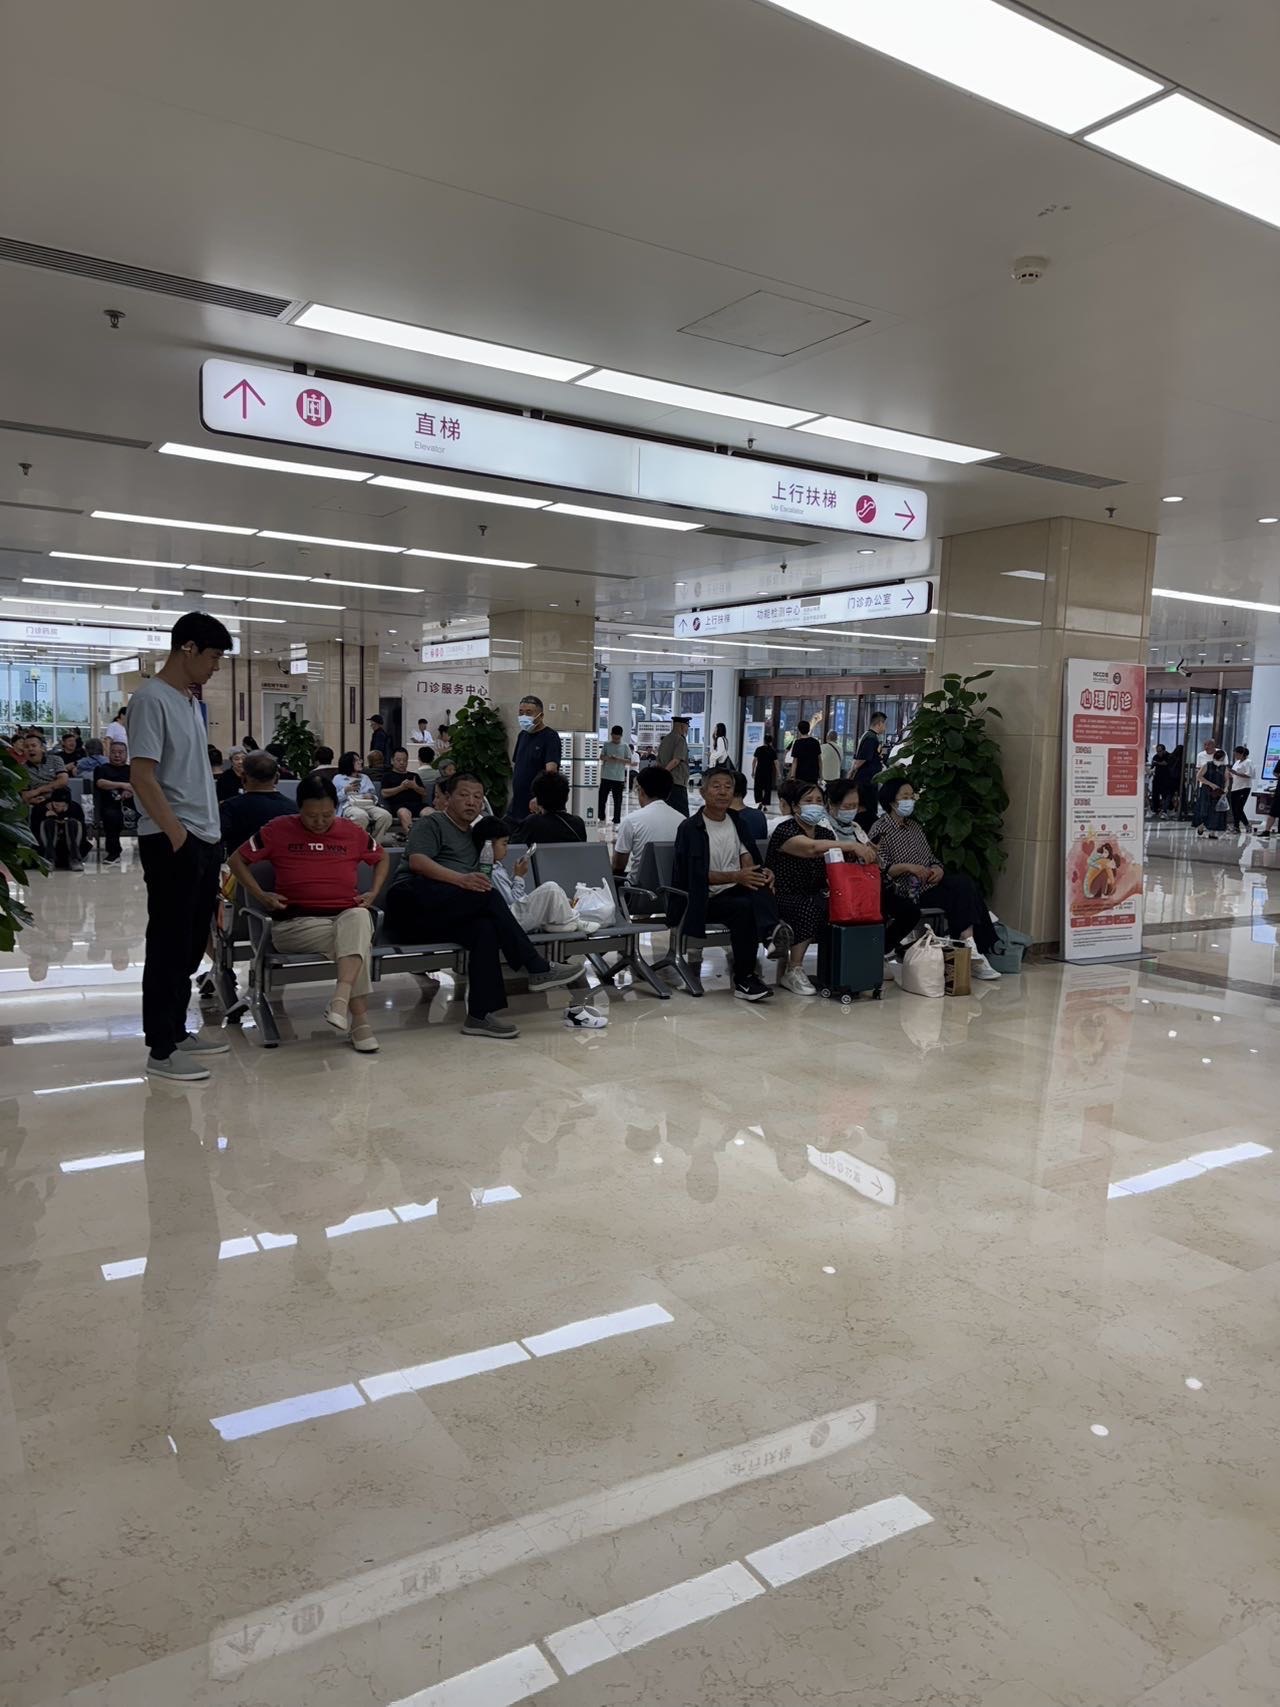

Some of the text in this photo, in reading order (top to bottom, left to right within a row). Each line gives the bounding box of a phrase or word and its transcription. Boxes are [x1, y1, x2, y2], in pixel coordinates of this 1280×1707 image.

[415, 412, 461, 441] 直梯
[414, 440, 446, 453] Elevator
[771, 480, 837, 509] 上行扶梯
[848, 593, 892, 609] 门诊办公室
[704, 614, 731, 626] 上行扶梯
[756, 605, 800, 621] 功能检测中心
[416, 680, 489, 697] 门诊服务中心
[1080, 688, 1133, 712] 心理门诊
[307, 842, 324, 851] TO
